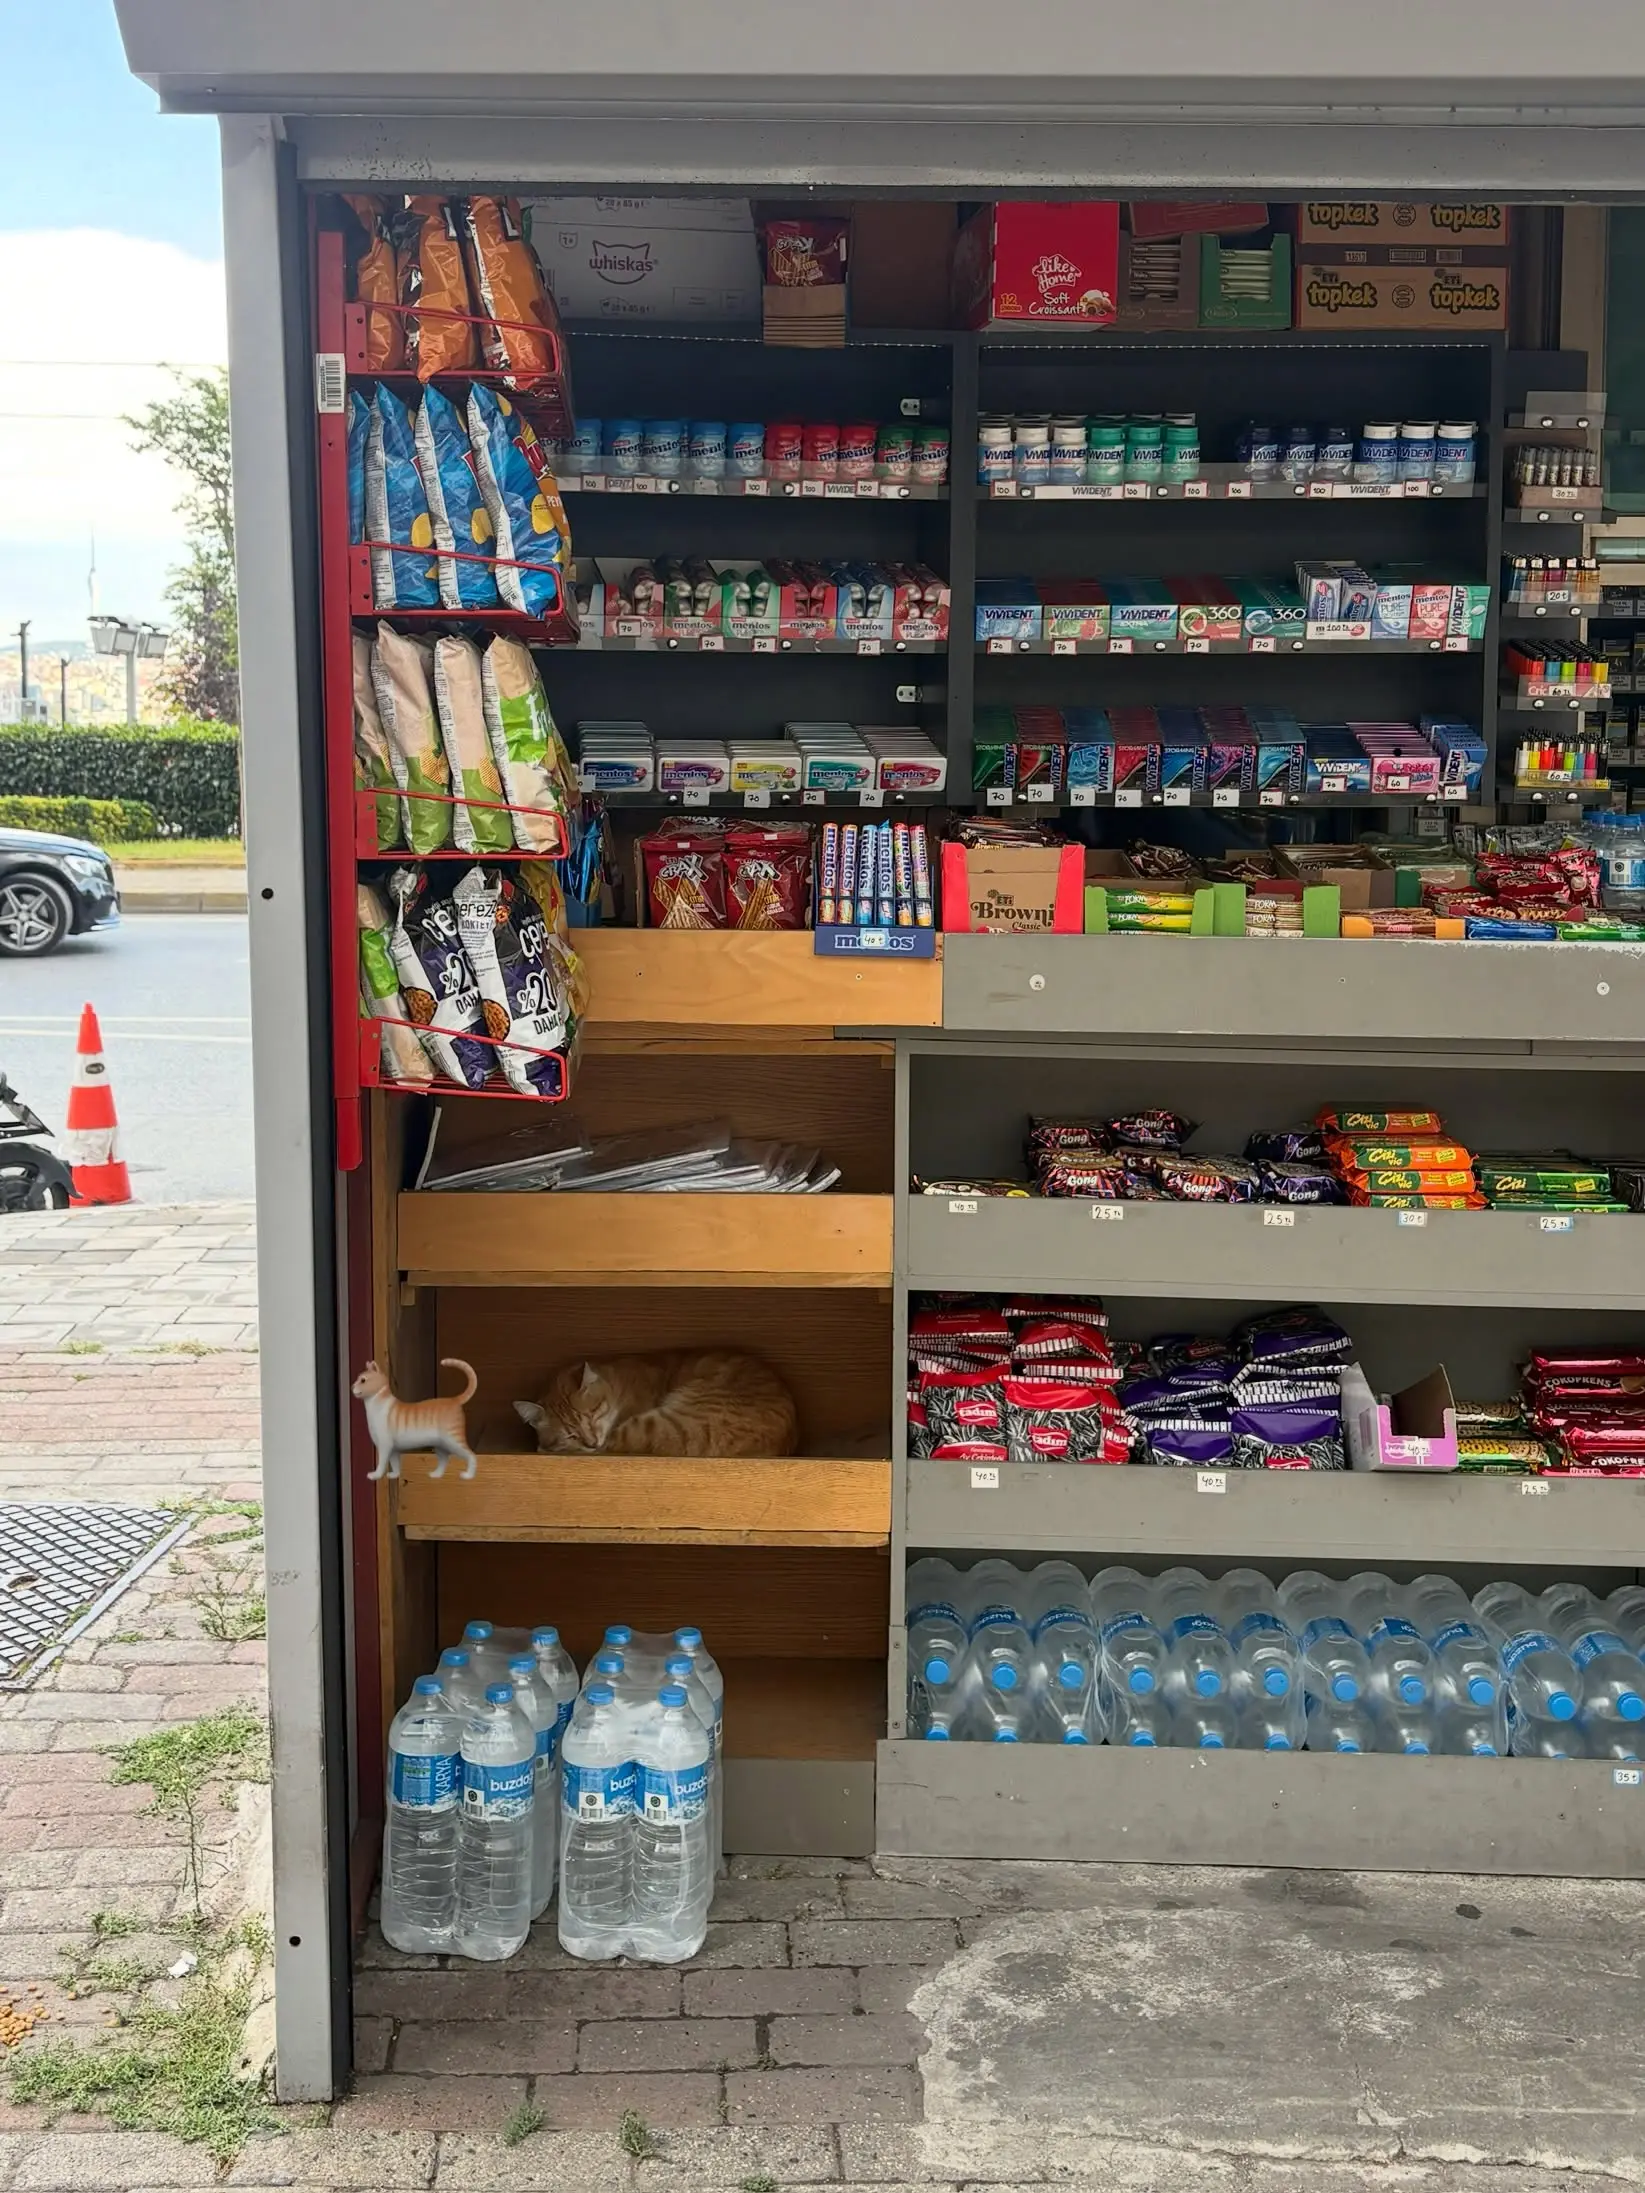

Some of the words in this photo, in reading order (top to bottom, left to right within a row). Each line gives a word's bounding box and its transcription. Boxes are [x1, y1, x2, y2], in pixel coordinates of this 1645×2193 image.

[1308, 203, 1378, 230] topkek
[1431, 204, 1500, 232] topkek
[589, 255, 653, 272] whiskas
[1037, 272, 1077, 293] Home
[1000, 294, 1017, 305] 12
[1043, 292, 1070, 306] Soft
[1307, 281, 1378, 313] topkek
[1430, 283, 1500, 315] topkek
[1029, 299, 1087, 316] Croissant
[1378, 592, 1411, 604] mentos
[1415, 593, 1449, 604] mentos
[1550, 592, 1561, 601] 20
[1207, 606, 1240, 620] 360
[1273, 608, 1306, 621] 360
[673, 620, 713, 630] mentos
[732, 620, 771, 630] mentos
[846, 623, 883, 632] mentos
[1326, 624, 1341, 632] 100
[756, 641, 768, 649] 70
[861, 644, 872, 652] 70
[1112, 642, 1123, 650] 70
[1255, 641, 1270, 649] 70
[1528, 684, 1548, 697] Cric
[588, 768, 632, 779] mentos
[664, 769, 708, 780] mentos
[811, 769, 855, 779] mentos
[1549, 771, 1561, 780] 60
[1325, 781, 1336, 789] 70
[1390, 780, 1401, 788] 60
[805, 793, 817, 801] 70
[992, 792, 1005, 800] 70
[1029, 789, 1043, 798] 70
[1073, 794, 1085, 802] 70
[917, 831, 928, 873] mentos
[824, 827, 836, 889] mentos
[843, 829, 855, 891] mentos
[881, 832, 890, 893] mentos
[900, 831, 912, 891] mentos
[658, 852, 710, 883] CRAX
[1254, 900, 1277, 909] FORM
[970, 901, 1055, 928] Browni
[1252, 914, 1276, 924] FORM
[1011, 920, 1041, 931] Classic
[835, 934, 916, 950] mos
[1136, 1118, 1163, 1129] Gong
[1059, 1134, 1087, 1145] Gong
[1296, 1144, 1321, 1159] Gong
[1067, 1175, 1097, 1186] Gong
[1183, 1182, 1213, 1195] Gong
[1288, 1189, 1319, 1202] Gong
[954, 1203, 965, 1211] 40
[1094, 1206, 1111, 1220] 25
[1403, 1213, 1416, 1223] 30
[1267, 1213, 1283, 1226] 25
[1542, 1217, 1557, 1230] 25
[1407, 1444, 1420, 1456] 40
[1524, 1484, 1538, 1496] 25
[1617, 1772, 1630, 1782] 35
